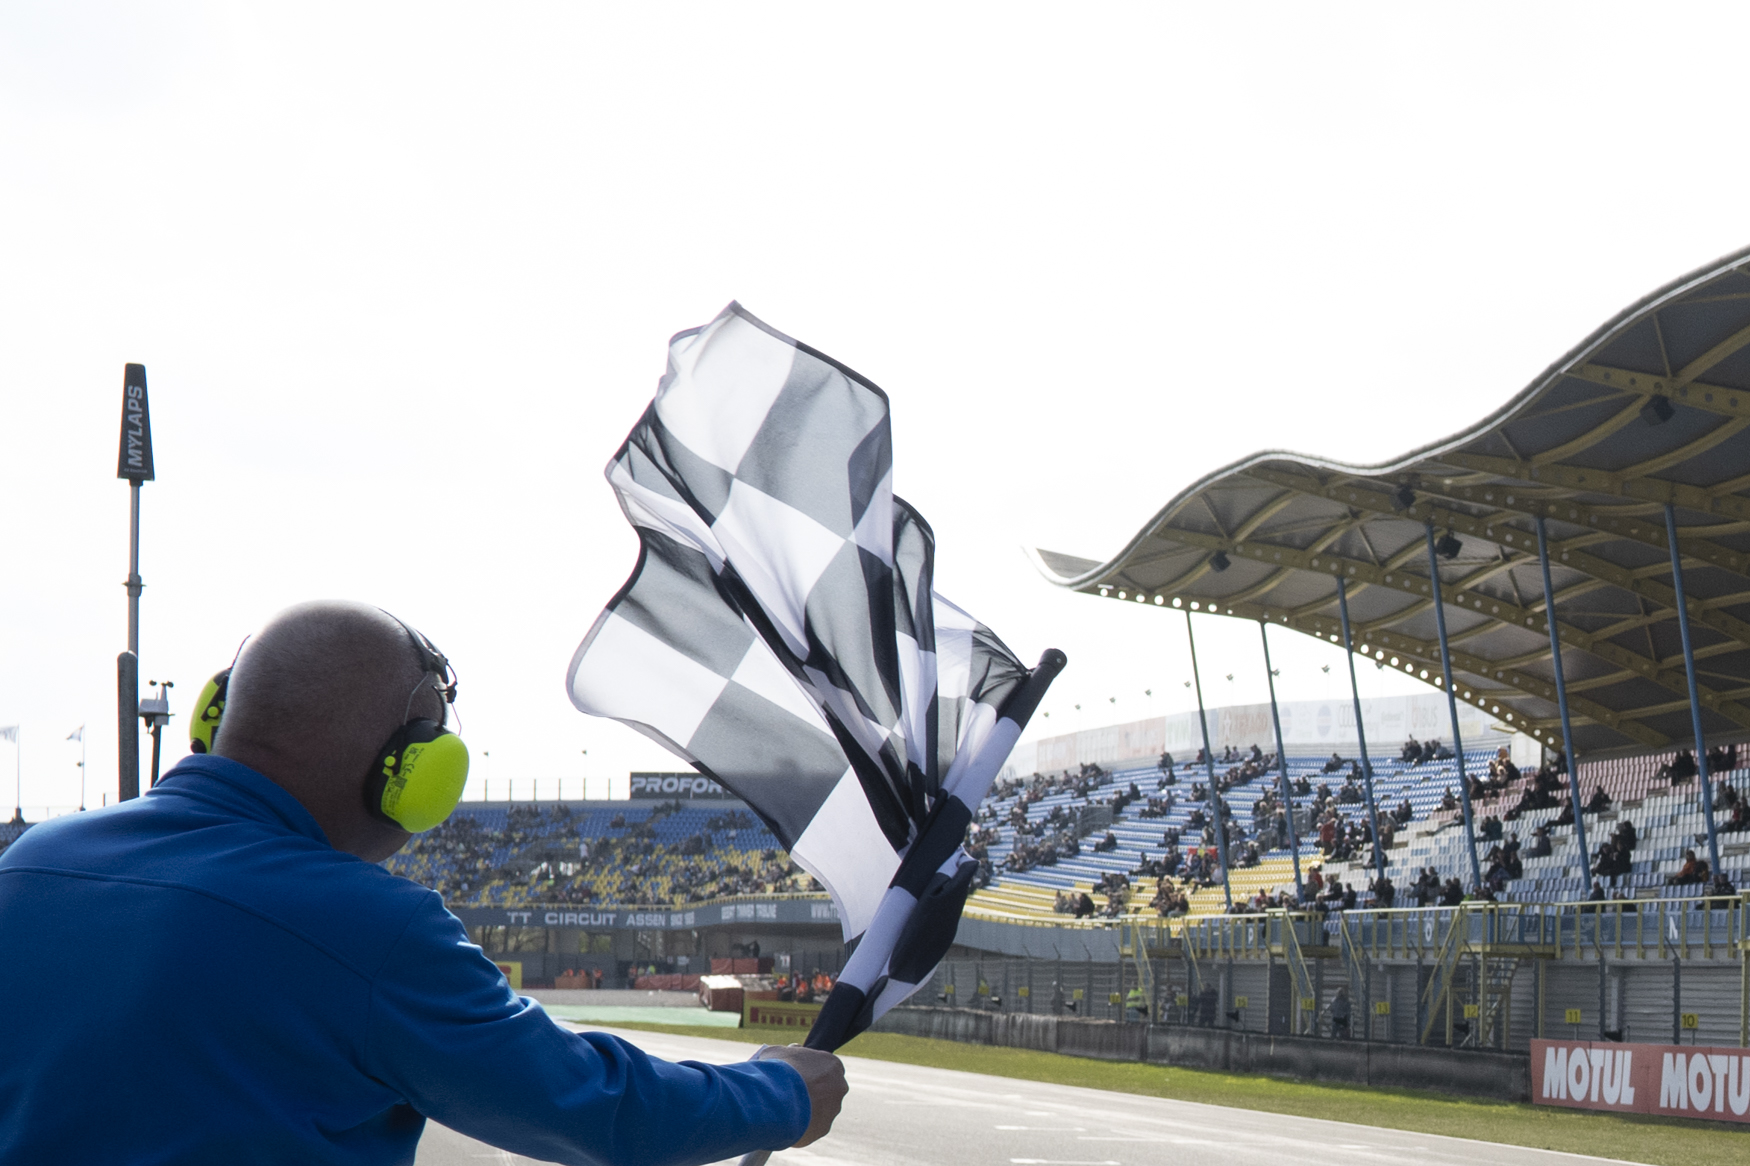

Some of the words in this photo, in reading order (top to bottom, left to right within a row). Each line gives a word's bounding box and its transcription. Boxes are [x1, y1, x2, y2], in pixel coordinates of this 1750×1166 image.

[128, 385, 142, 467] MYLAPS
[631, 777, 731, 794] PROFOR
[507, 911, 532, 924] TT
[544, 912, 617, 926] CIRCUIT
[626, 913, 666, 927] ASSEN
[1377, 1003, 1389, 1014] 13
[1466, 1005, 1477, 1017] 12
[1568, 1010, 1579, 1023] 11
[1682, 1014, 1694, 1028] 10
[1543, 1047, 1635, 1105] MOTUL
